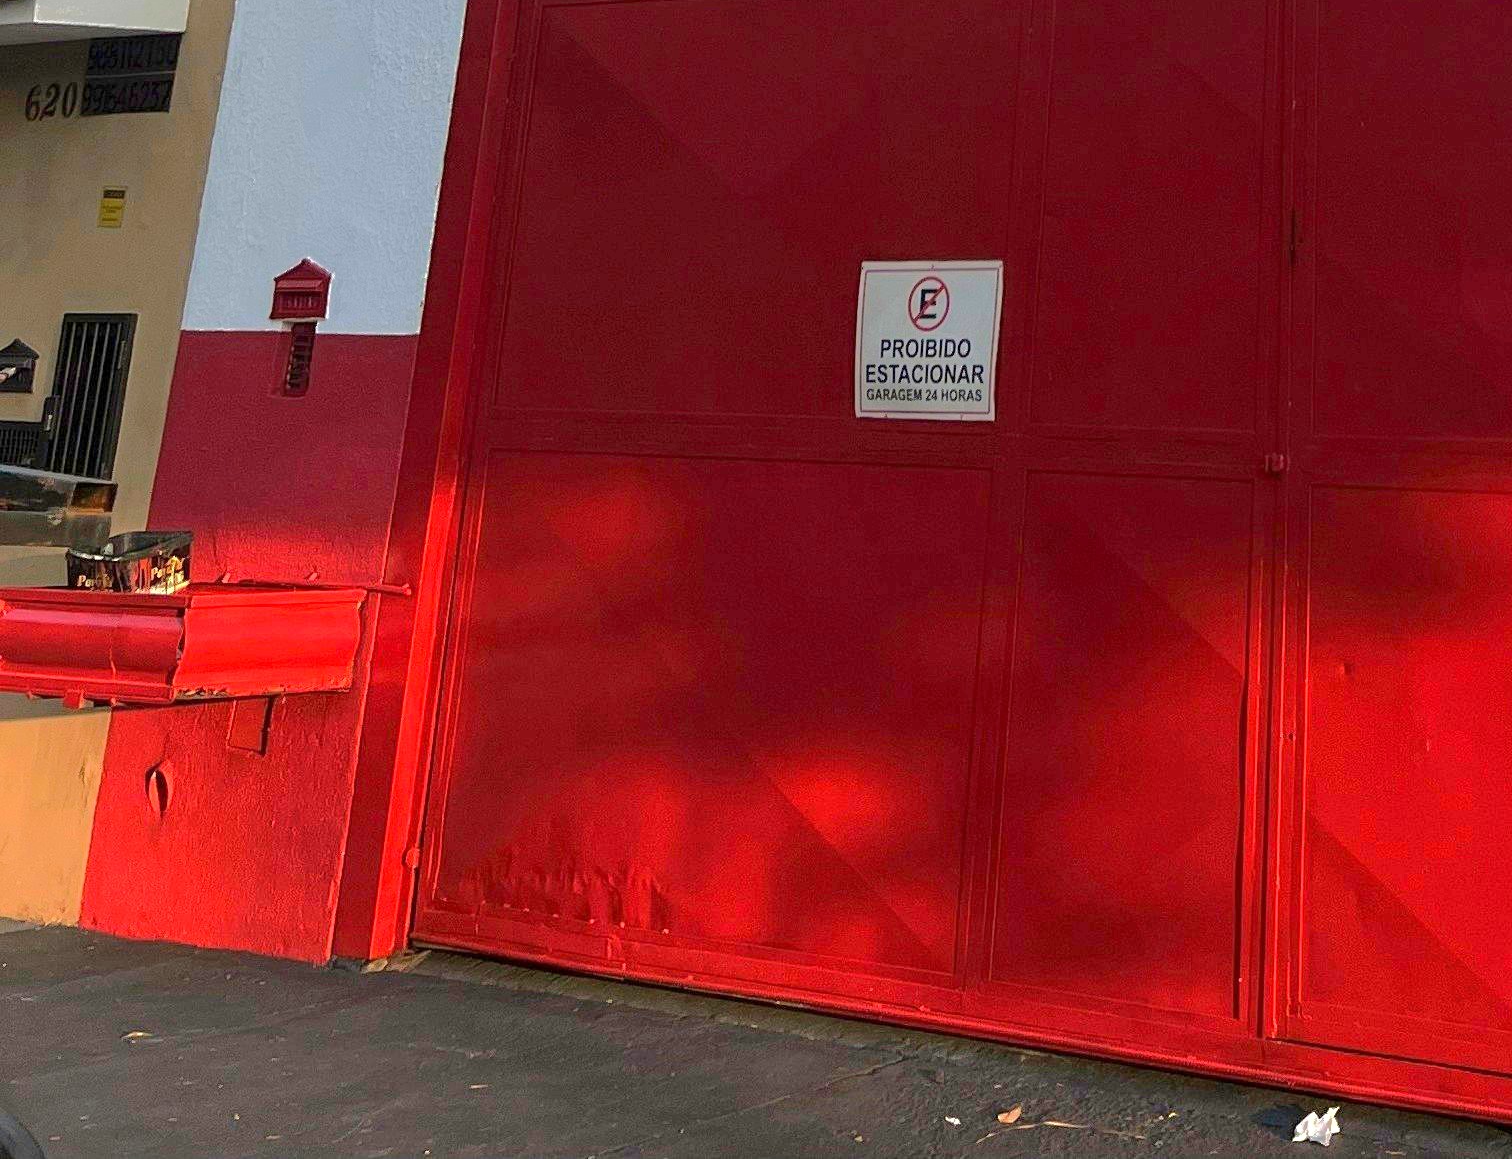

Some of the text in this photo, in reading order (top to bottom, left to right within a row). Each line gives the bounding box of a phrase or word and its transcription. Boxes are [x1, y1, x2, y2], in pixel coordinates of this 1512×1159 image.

[24, 81, 78, 122] 620
[880, 338, 972, 359] PROIBIDO
[865, 364, 984, 385] ESTACIONAR
[866, 388, 983, 402] GARAGEM 24 HORAS
